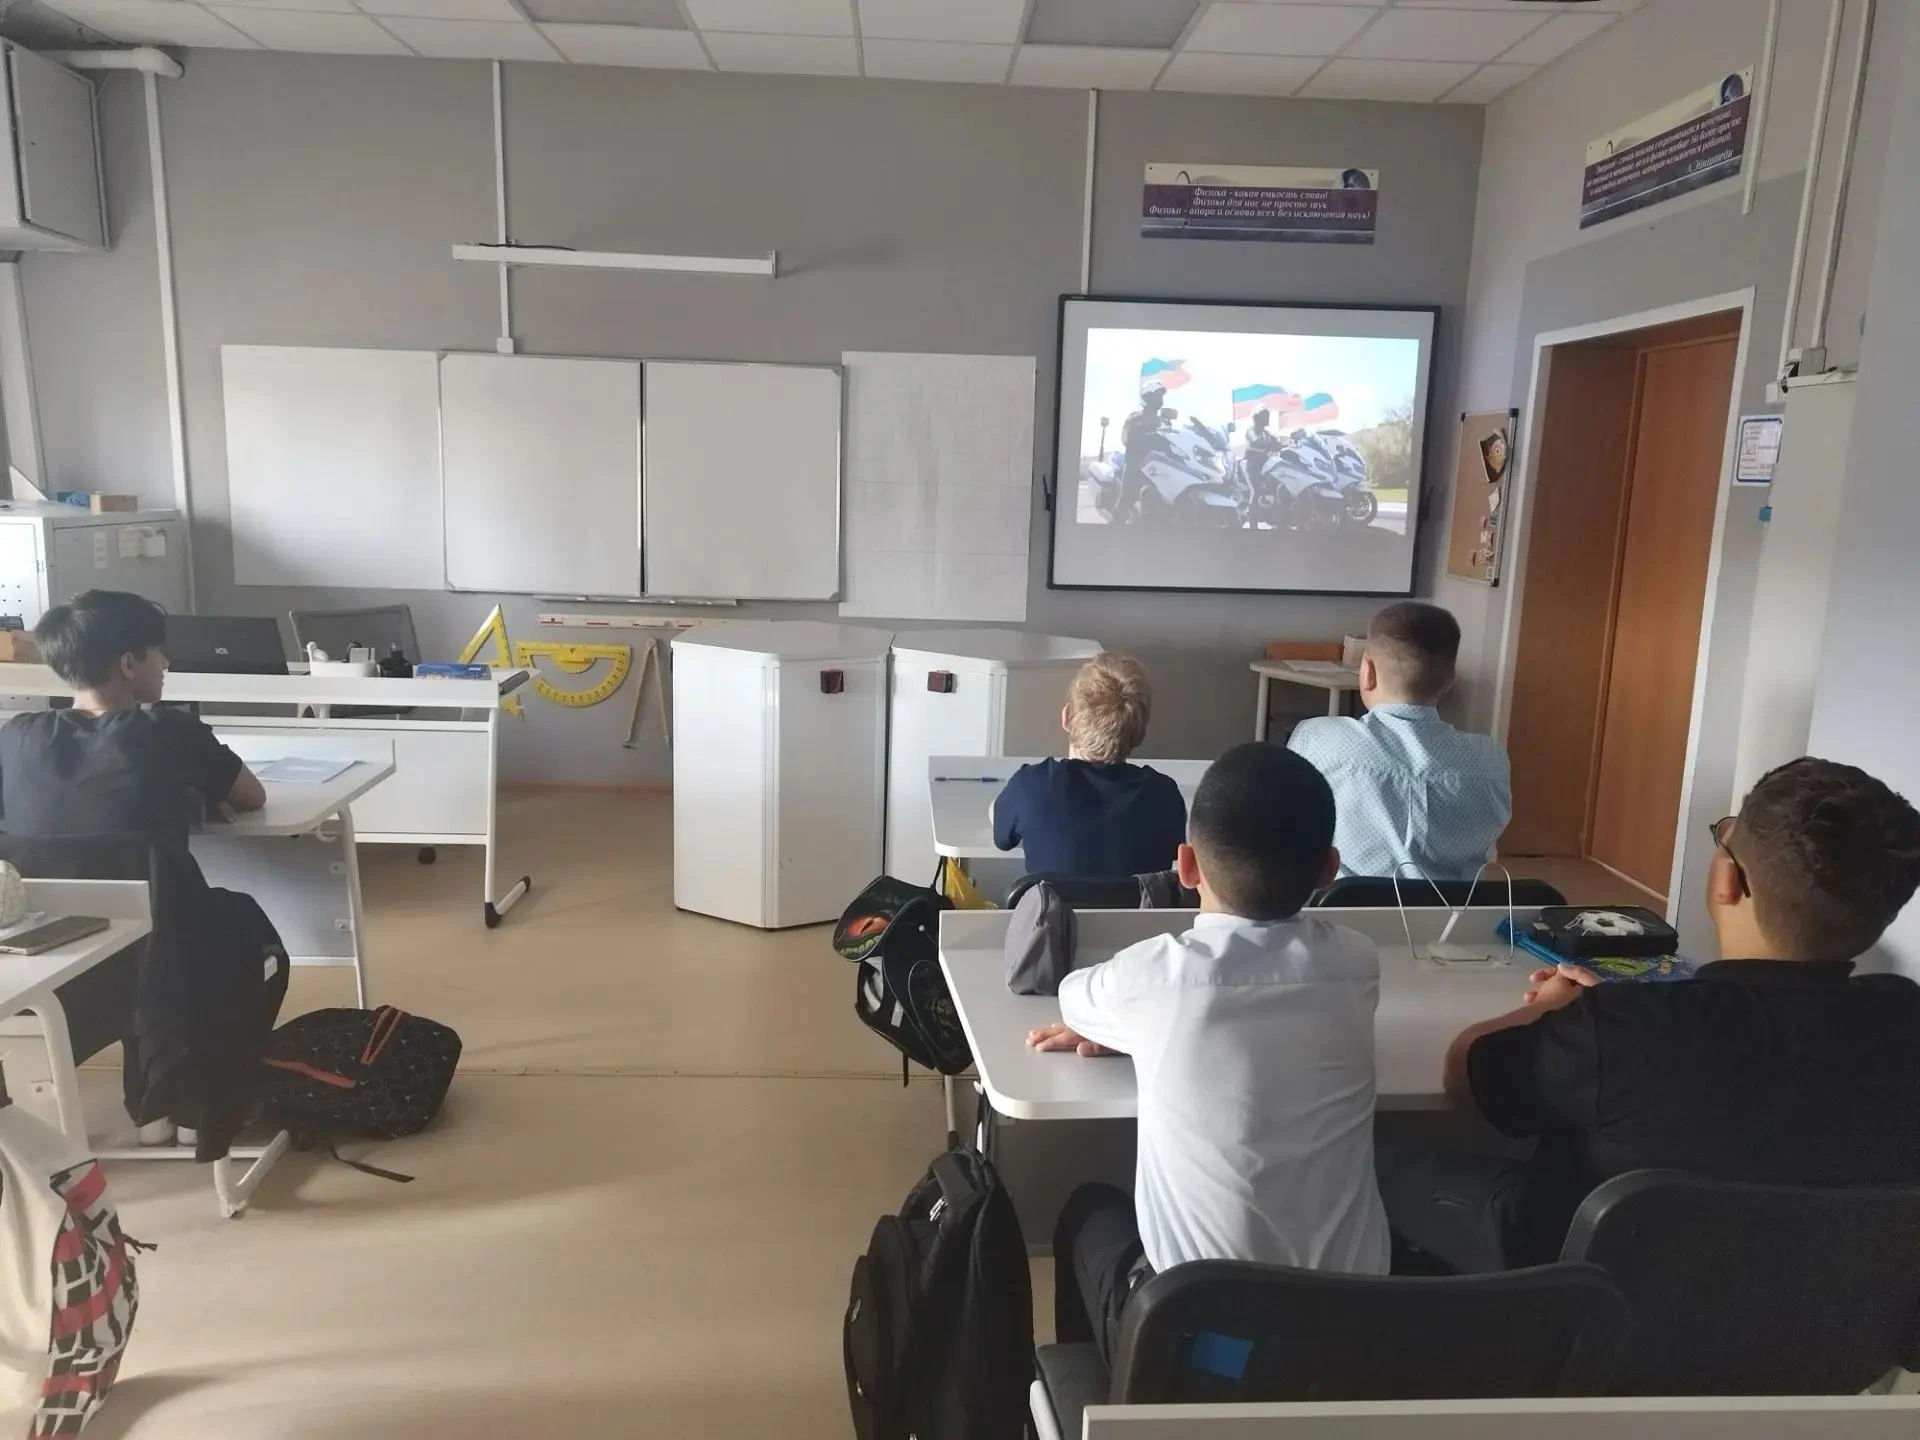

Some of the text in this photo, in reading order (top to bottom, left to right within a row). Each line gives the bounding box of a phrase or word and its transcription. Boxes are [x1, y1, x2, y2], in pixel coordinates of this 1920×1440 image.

[1194, 187, 1227, 197] Физика
[1193, 196, 1225, 206] Физика
[1149, 204, 1182, 214] Физика
